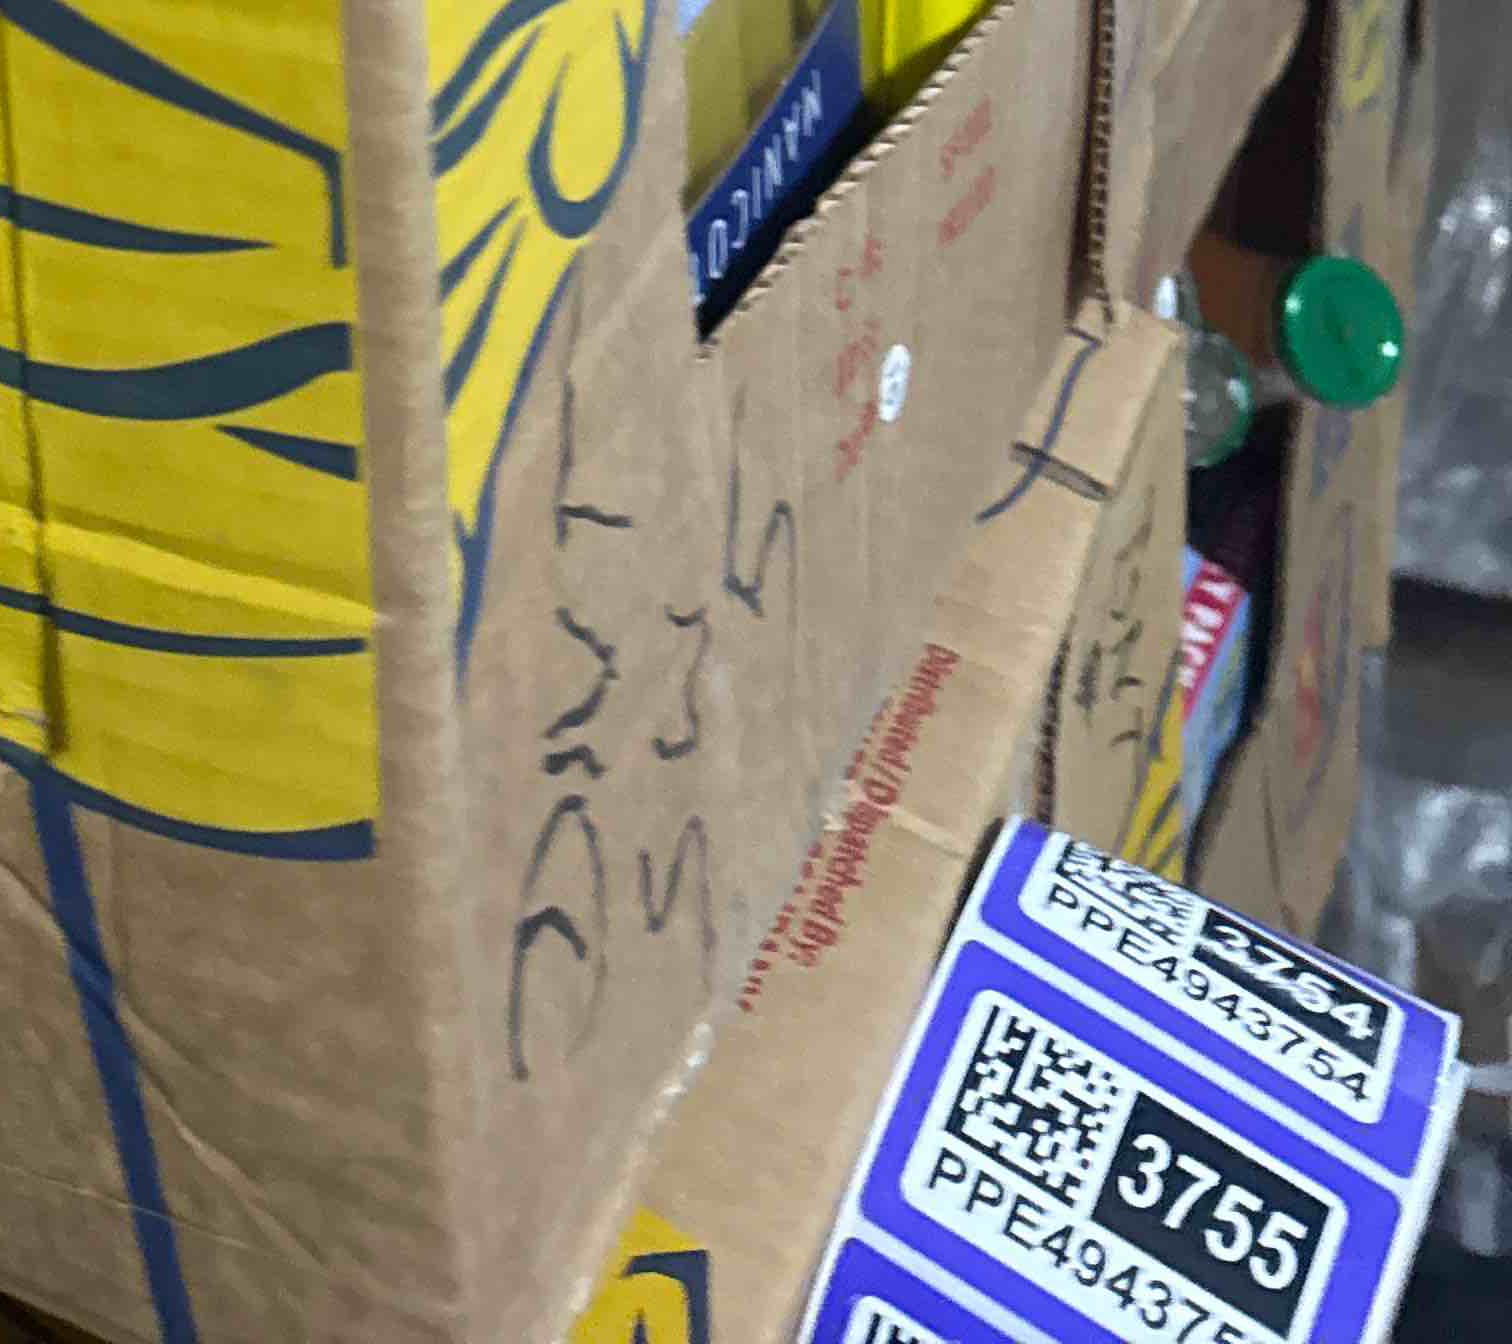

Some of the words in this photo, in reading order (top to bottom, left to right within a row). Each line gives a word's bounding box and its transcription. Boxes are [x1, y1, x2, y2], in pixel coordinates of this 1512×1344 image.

[691, 68, 826, 310] MANICO
[1047, 882, 1371, 1105] PPE4943754
[1195, 920, 1379, 1043] 3754
[1118, 1132, 1311, 1292] 3755
